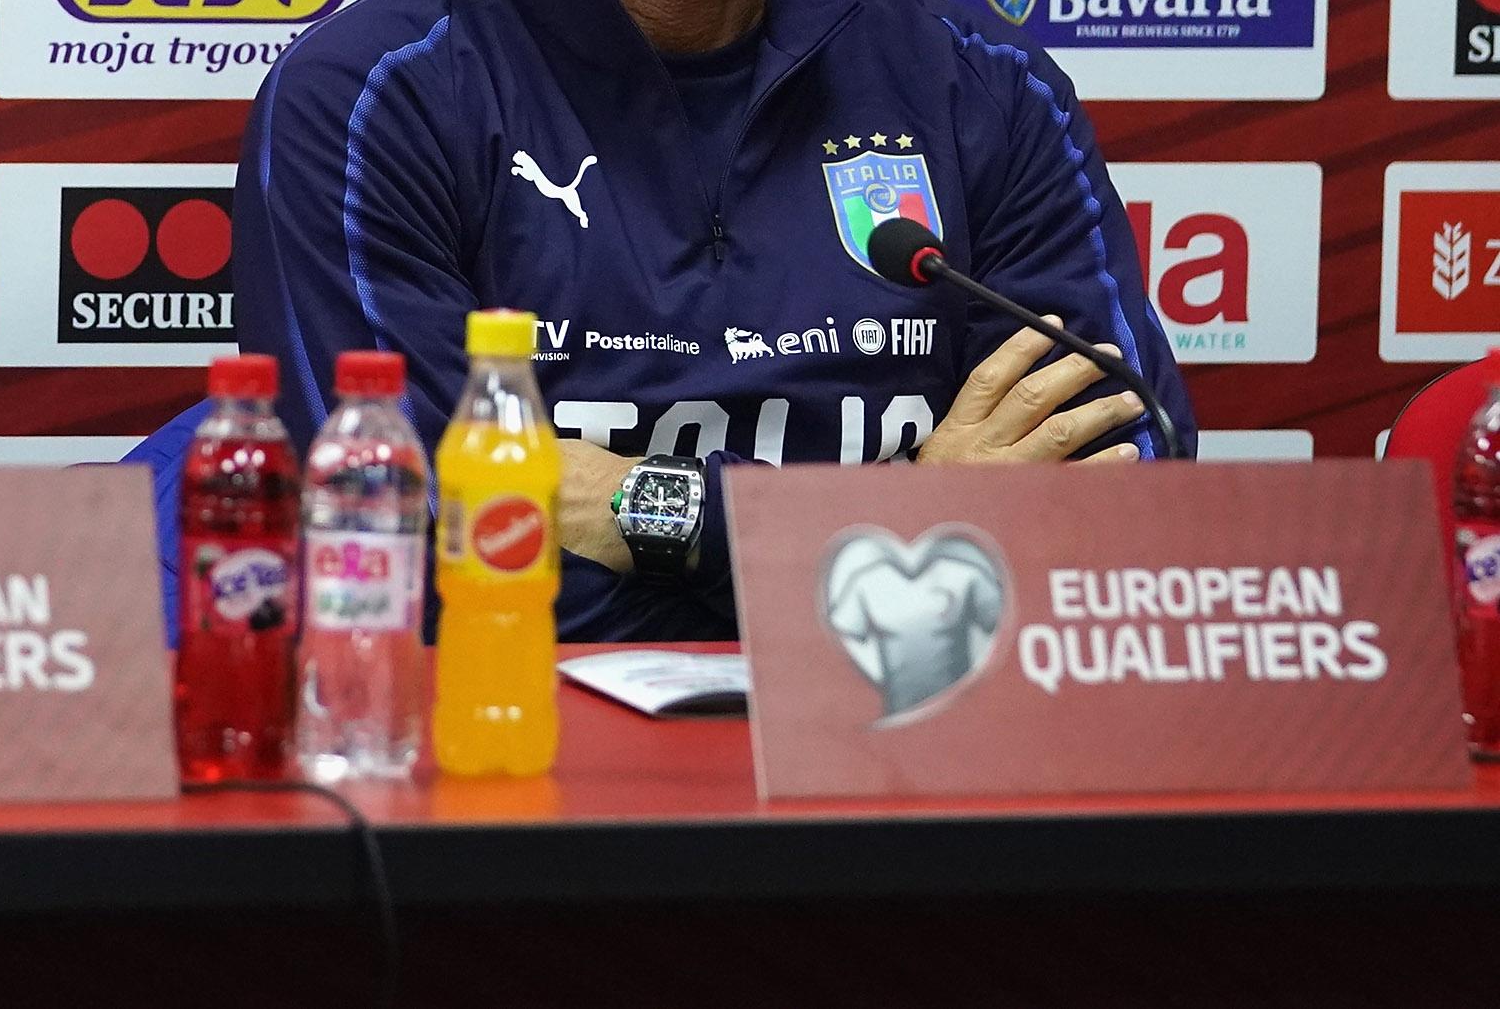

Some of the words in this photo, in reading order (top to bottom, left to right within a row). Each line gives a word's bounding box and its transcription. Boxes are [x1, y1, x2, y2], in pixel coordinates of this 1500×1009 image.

[49, 32, 155, 73] moja
[168, 37, 296, 73] trgov
[835, 165, 918, 186] ITALIA
[72, 292, 235, 330] SECURI
[585, 331, 700, 356] Posteitaliane
[776, 316, 840, 356] eni
[861, 329, 878, 344] FIAT
[890, 318, 937, 355] FIAT
[1175, 332, 1246, 349] WATER
[1049, 567, 1341, 619] EUROPEAN
[1018, 621, 1386, 693] QUALIFIERS
